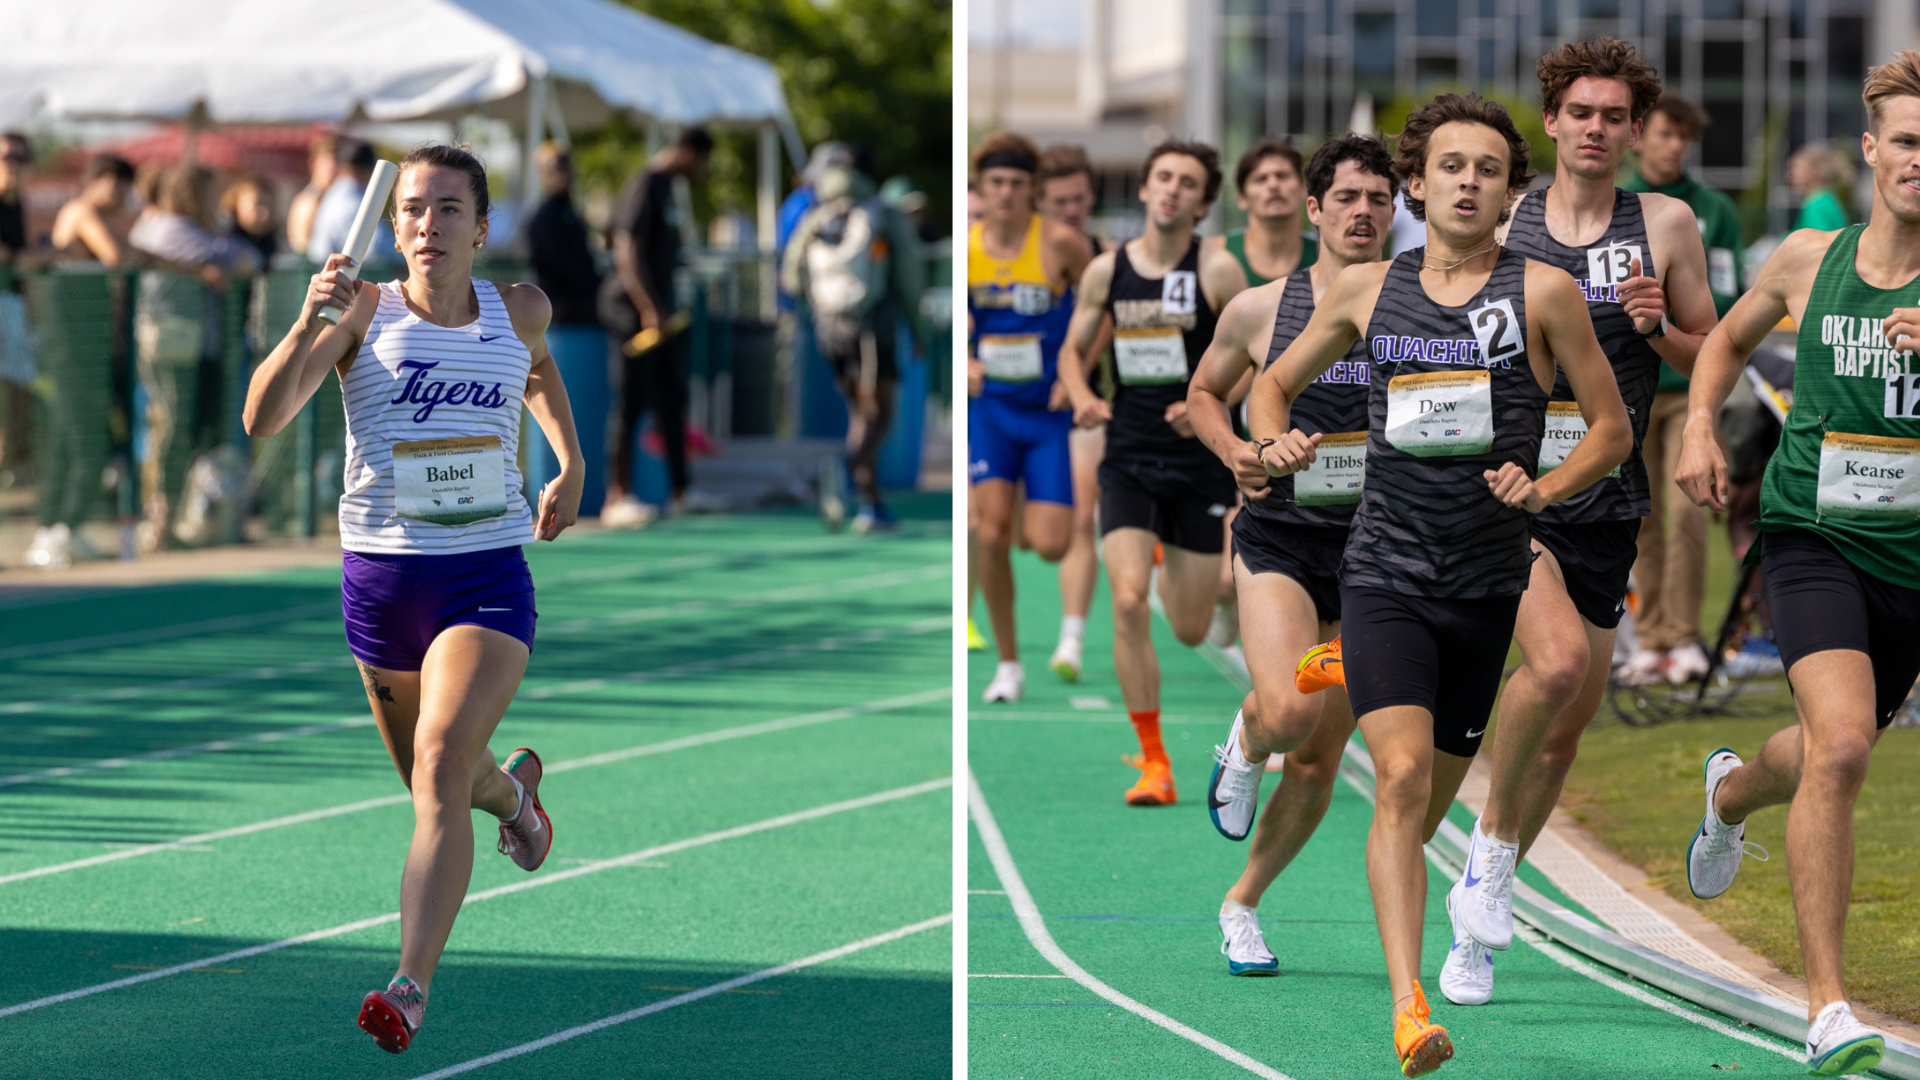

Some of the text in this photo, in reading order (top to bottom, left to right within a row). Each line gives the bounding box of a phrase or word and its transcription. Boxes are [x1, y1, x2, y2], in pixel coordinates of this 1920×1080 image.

[1597, 248, 1632, 284] 13
[1169, 277, 1187, 309] 4
[1477, 307, 1518, 360] 2
[1821, 314, 1911, 349] OKLAH
[1372, 335, 1511, 370] OUACHI
[1833, 346, 1913, 379] BAPTIST
[391, 360, 507, 423] Tigers
[1418, 399, 1458, 415] Dew
[1444, 429, 1461, 437] GAC
[1544, 429, 1587, 440] reen
[1873, 448, 1911, 456] Championships
[1322, 455, 1363, 469] Tibbs
[1844, 460, 1905, 480] Kearse
[425, 463, 475, 483] Babel
[1347, 481, 1362, 489] GAC
[1852, 481, 1894, 491] Oklahoma Baptist
[457, 496, 474, 505] GAC
[1877, 495, 1895, 503] GAC
